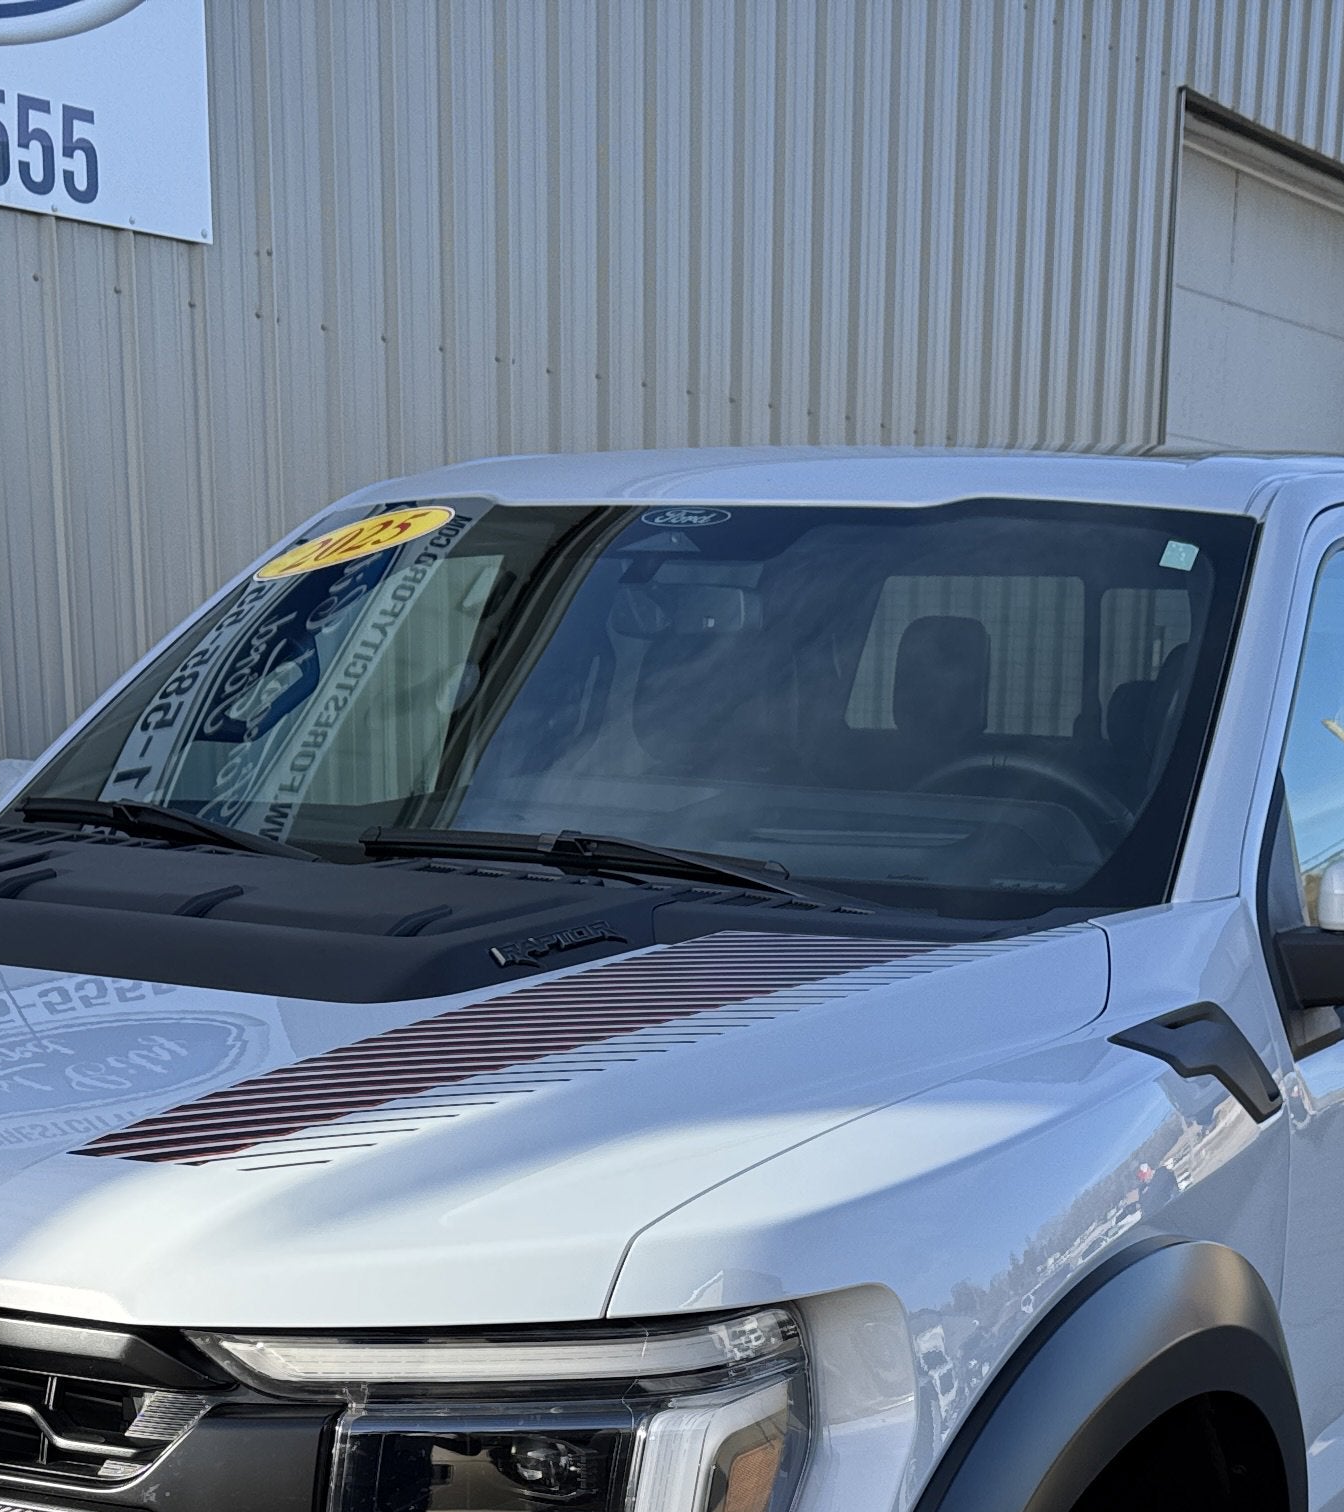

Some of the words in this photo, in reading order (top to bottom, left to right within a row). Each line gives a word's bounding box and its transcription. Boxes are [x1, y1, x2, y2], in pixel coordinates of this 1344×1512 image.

[654, 509, 717, 524] Ford
[278, 511, 432, 573] 2025
[488, 919, 628, 969] RAPTOR
